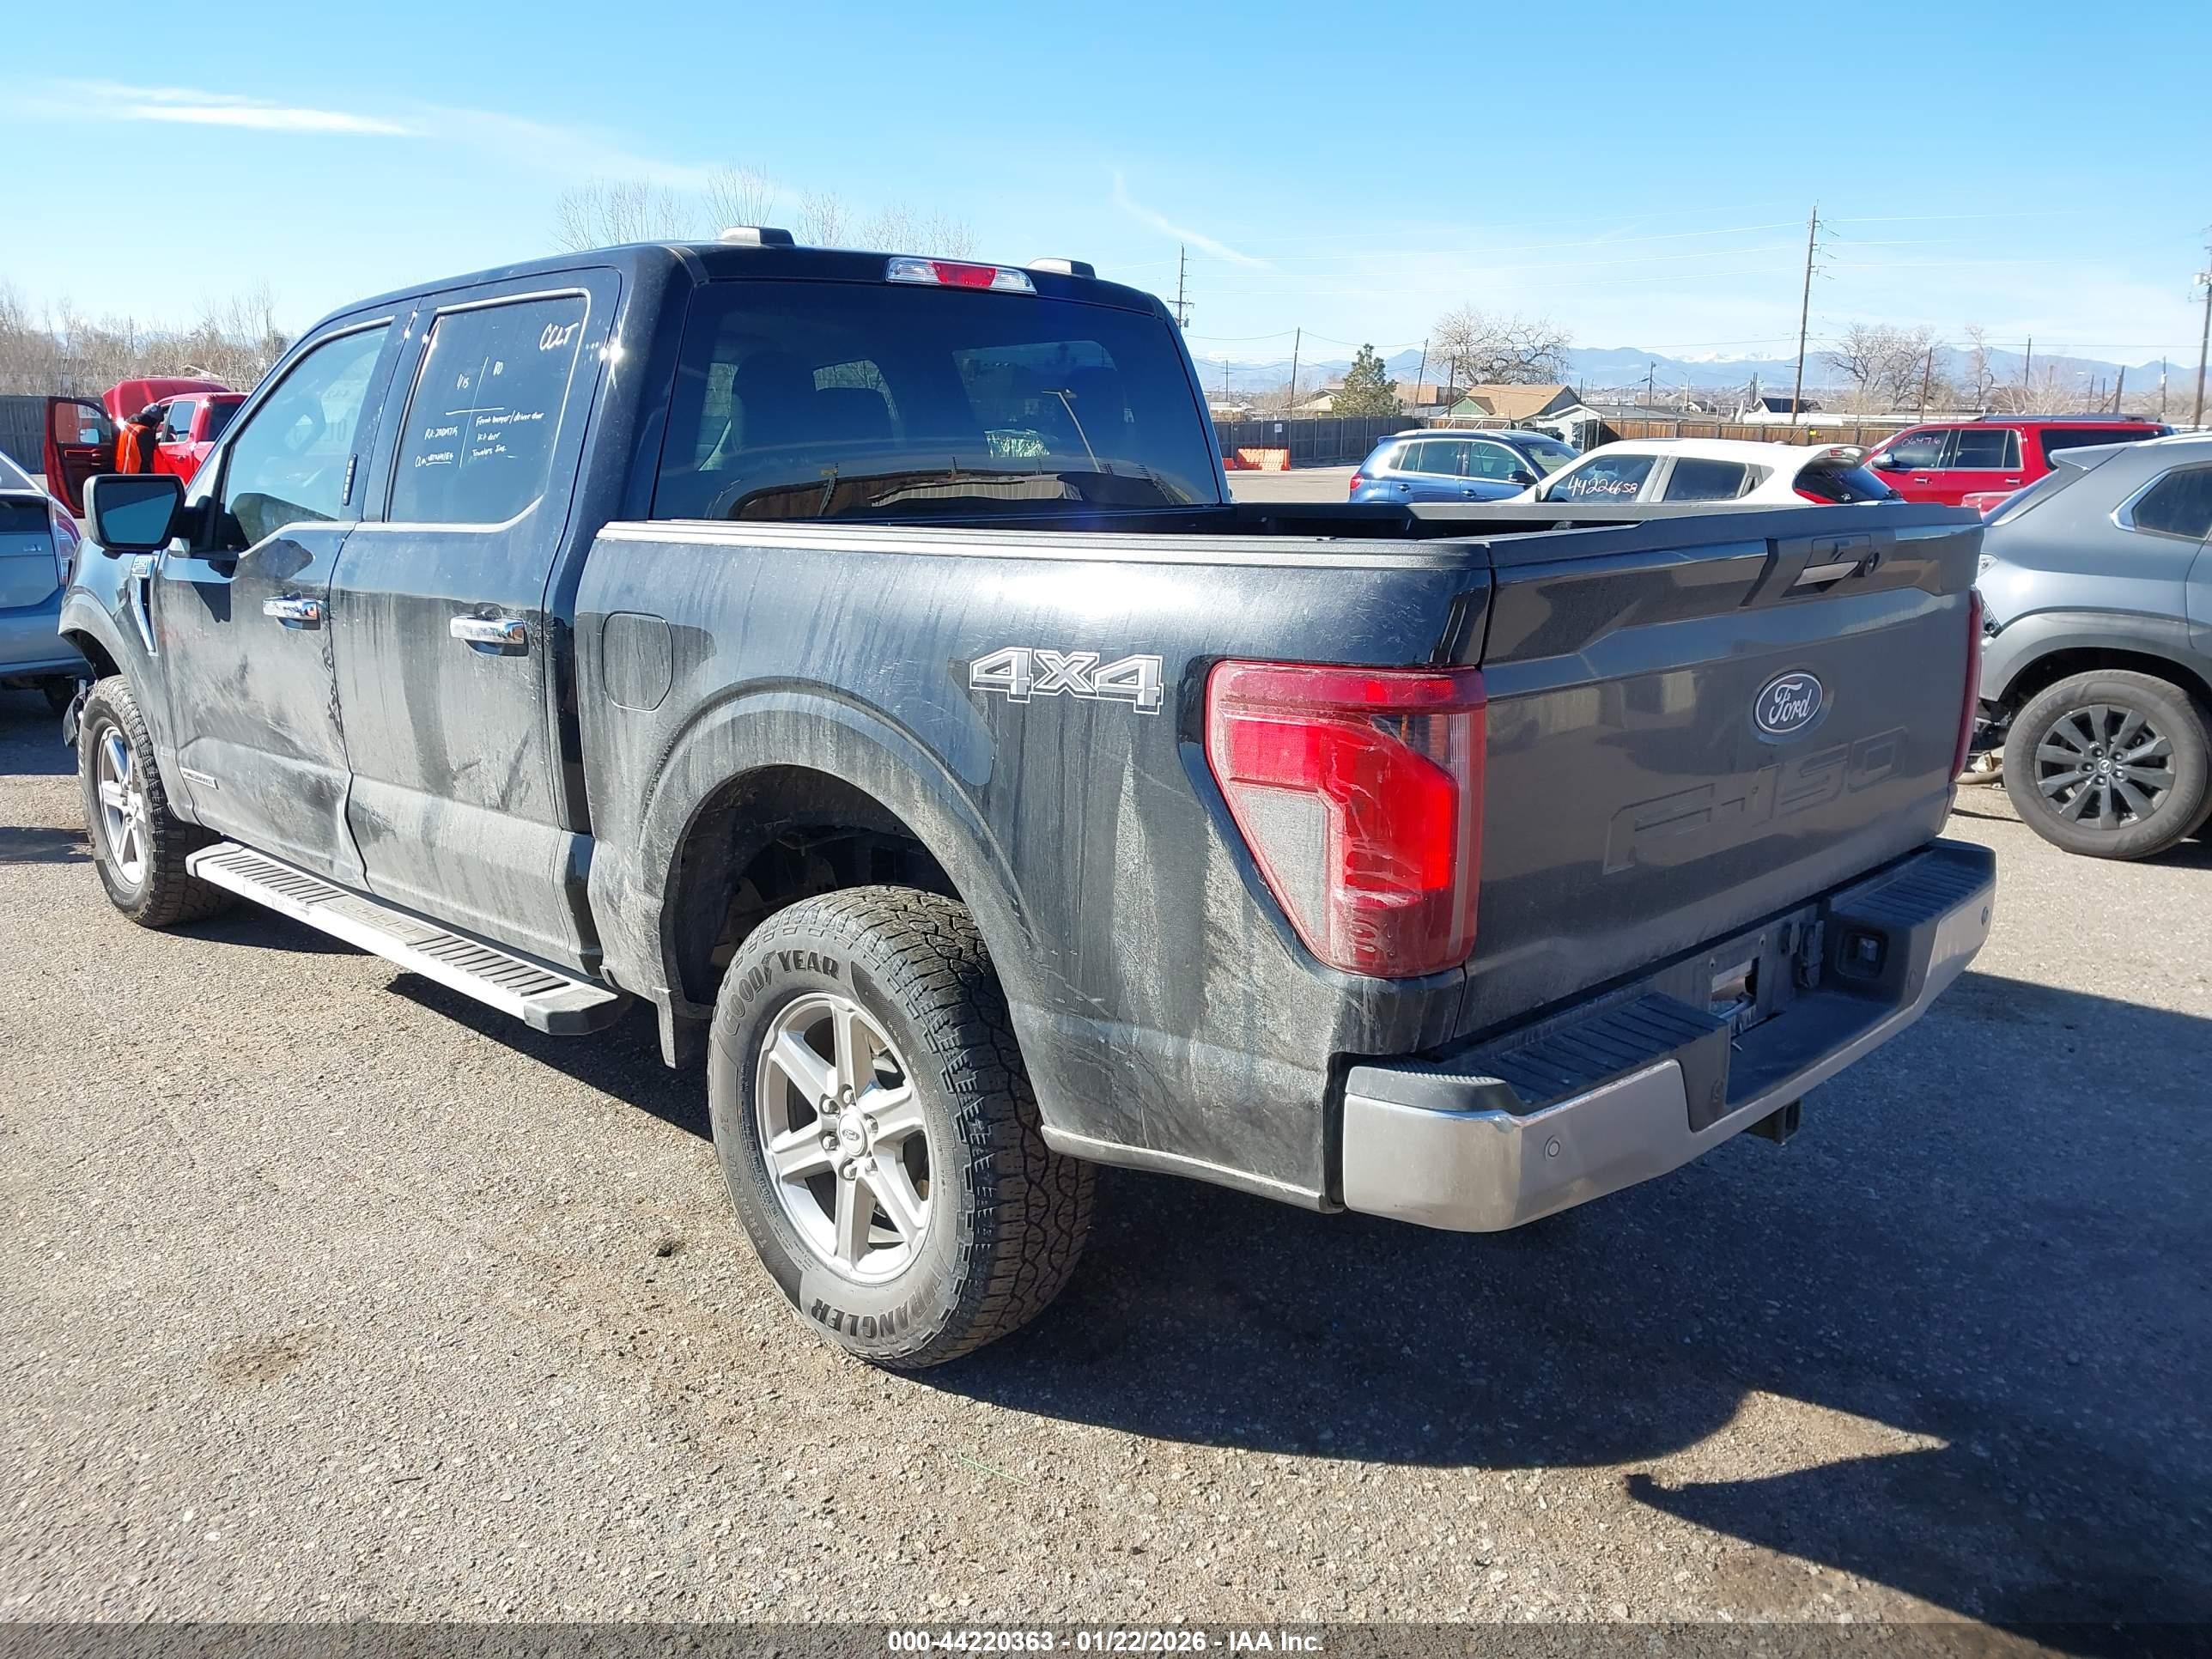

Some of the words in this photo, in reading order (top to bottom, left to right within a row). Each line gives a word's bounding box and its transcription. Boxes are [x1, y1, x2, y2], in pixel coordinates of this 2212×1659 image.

[1568, 474, 1639, 497] 44226658
[969, 647, 1164, 715] 4X4
[1768, 682, 1814, 725] Ford
[1602, 726, 1910, 876] F-150
